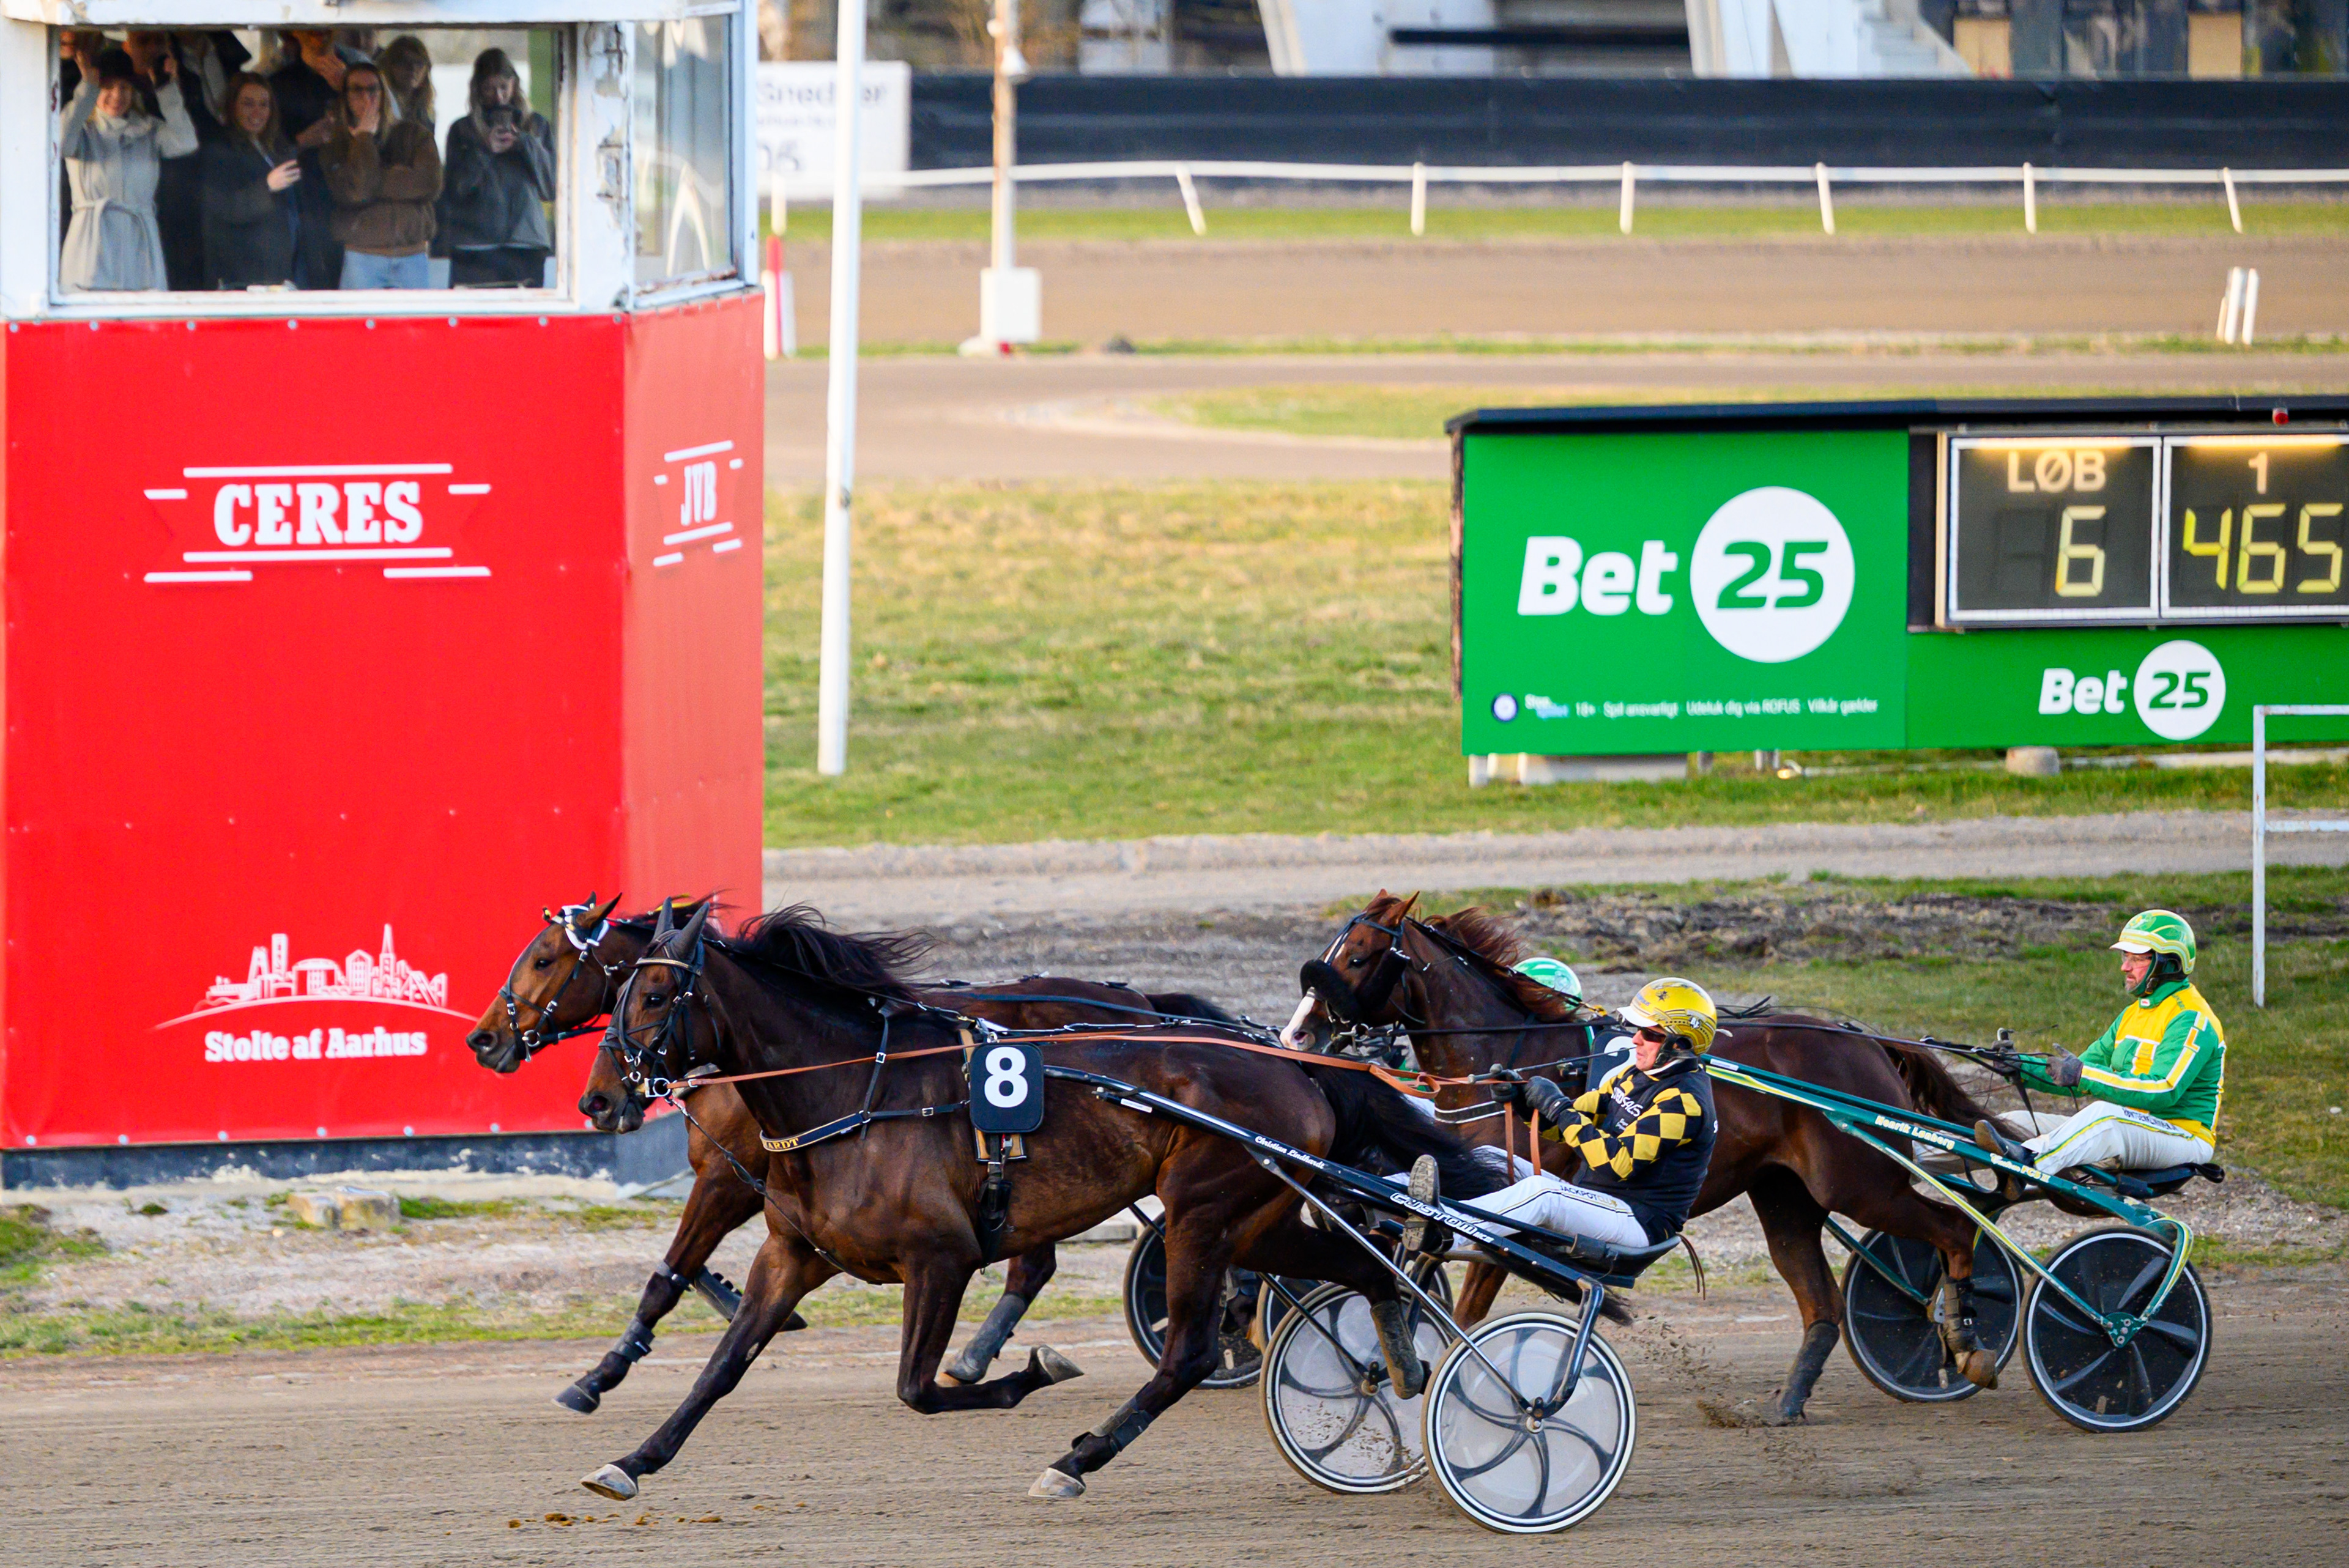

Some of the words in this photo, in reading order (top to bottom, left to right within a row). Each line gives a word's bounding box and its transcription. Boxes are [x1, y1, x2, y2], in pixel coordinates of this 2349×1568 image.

[2008, 449, 2106, 494] LØB
[2248, 452, 2268, 494] 1
[213, 481, 422, 546] CERES
[2055, 505, 2106, 597] 6
[2182, 503, 2343, 594] 465
[1518, 536, 1679, 616] Bet
[1716, 540, 1829, 609] 25
[2038, 668, 2128, 715] Bet
[2148, 671, 2211, 709] 25
[205, 1031, 289, 1062] Stolte
[292, 1029, 322, 1059] af
[325, 1027, 427, 1059] Aarhus
[984, 1046, 1028, 1108] 8
[1875, 1115, 1911, 1134] Henrik
[1255, 1136, 1287, 1153] Christian
[1287, 1150, 1324, 1169] Lindhardt
[1390, 1193, 1479, 1235] CUSTOM
